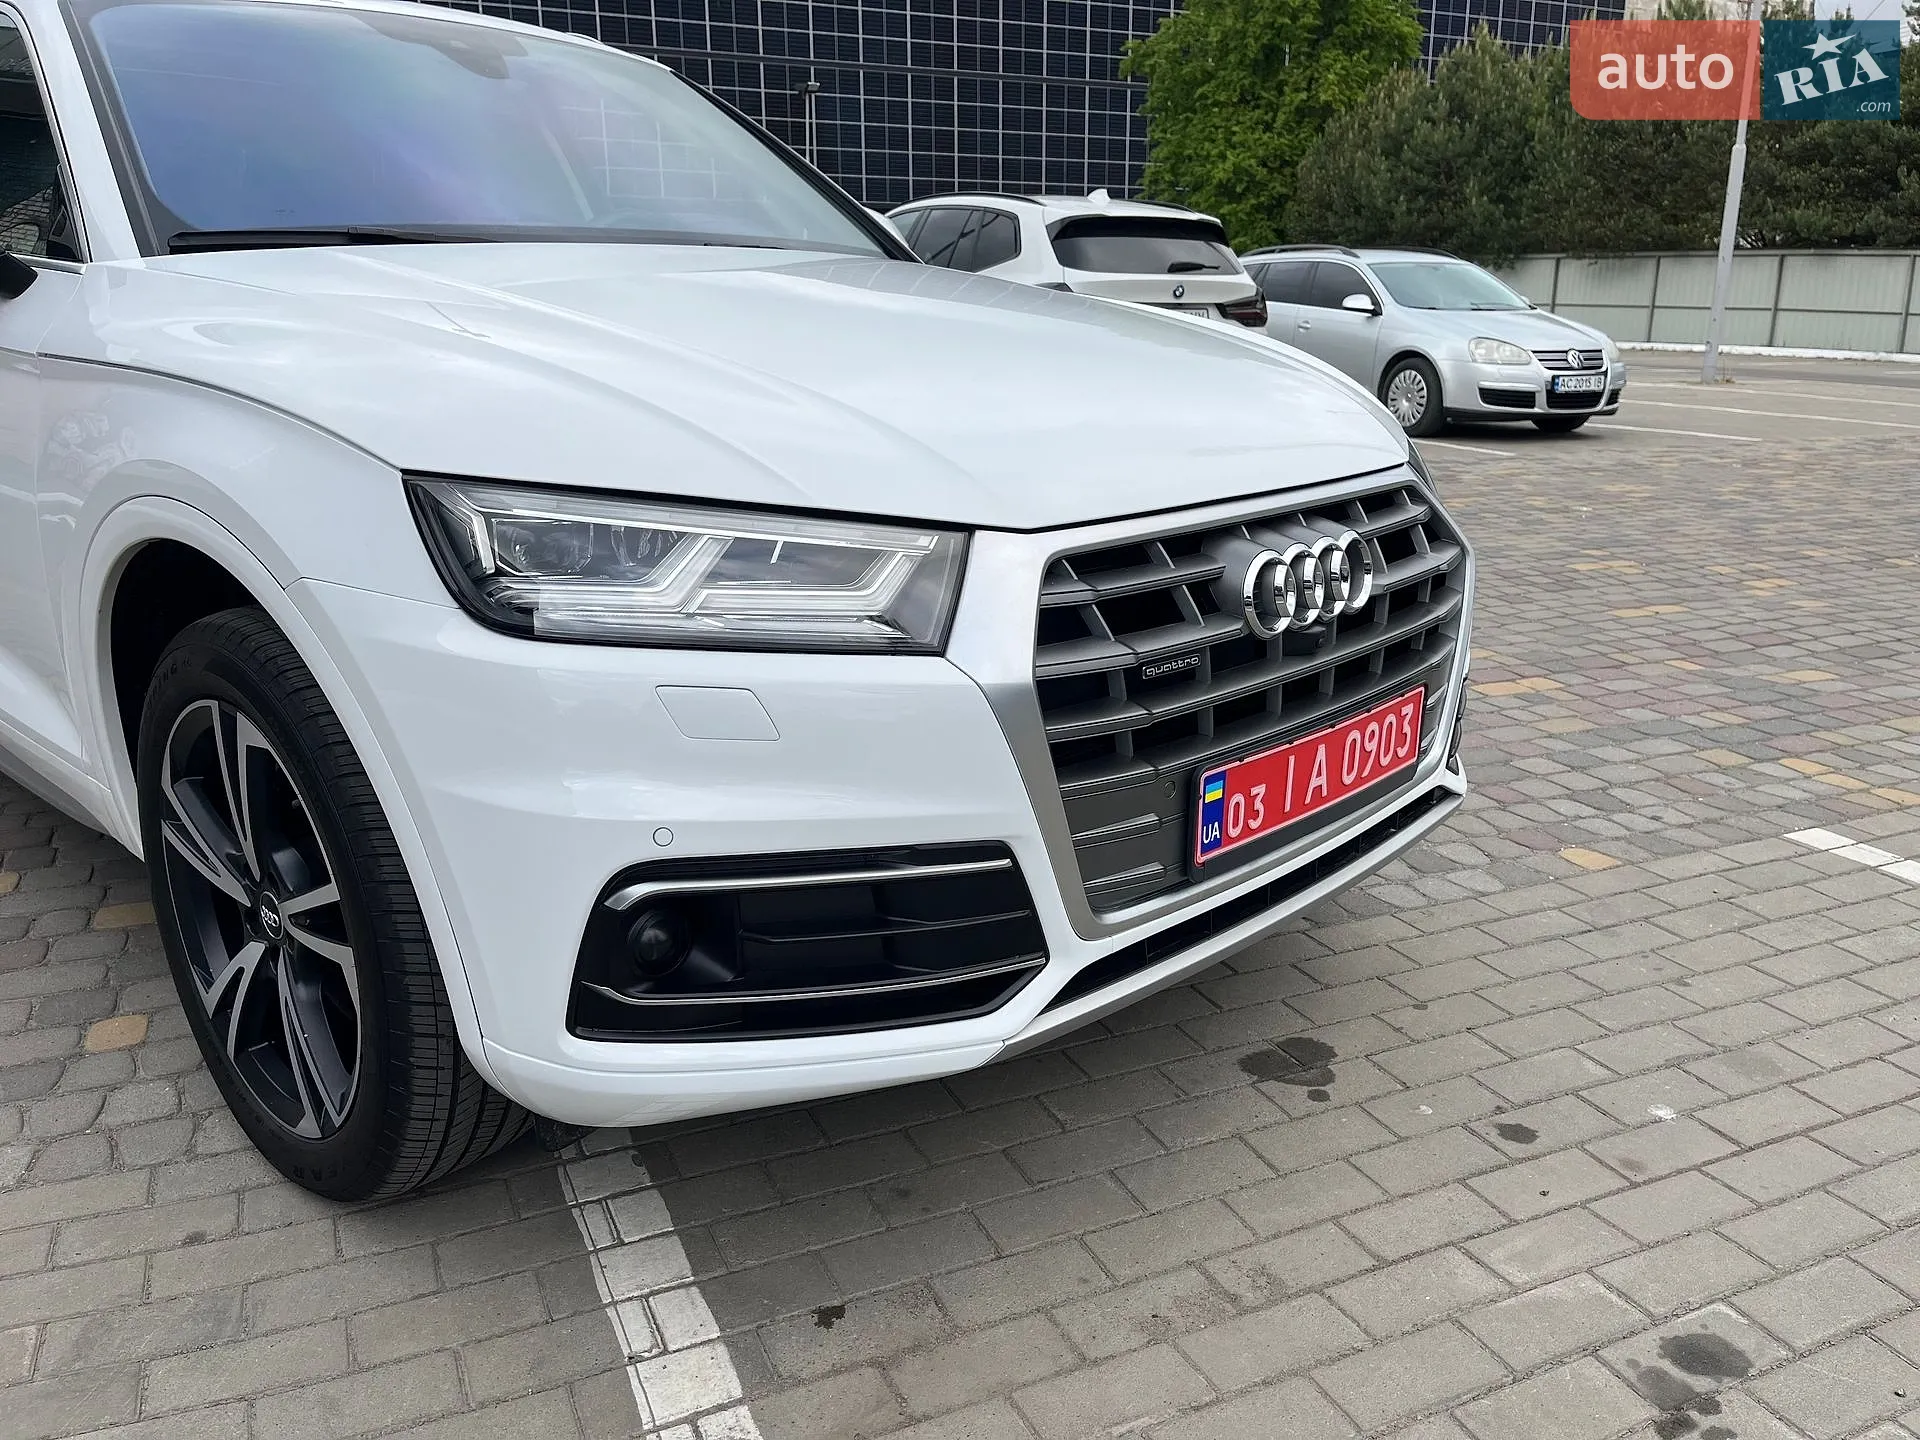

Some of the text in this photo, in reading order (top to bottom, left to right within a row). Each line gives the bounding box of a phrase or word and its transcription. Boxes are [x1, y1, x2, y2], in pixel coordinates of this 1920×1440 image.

[1560, 377, 1573, 389] AC
[1146, 657, 1199, 676] quattro
[1227, 783, 1266, 838] 03
[1341, 702, 1414, 786] 0903
[1203, 821, 1221, 844] UA
